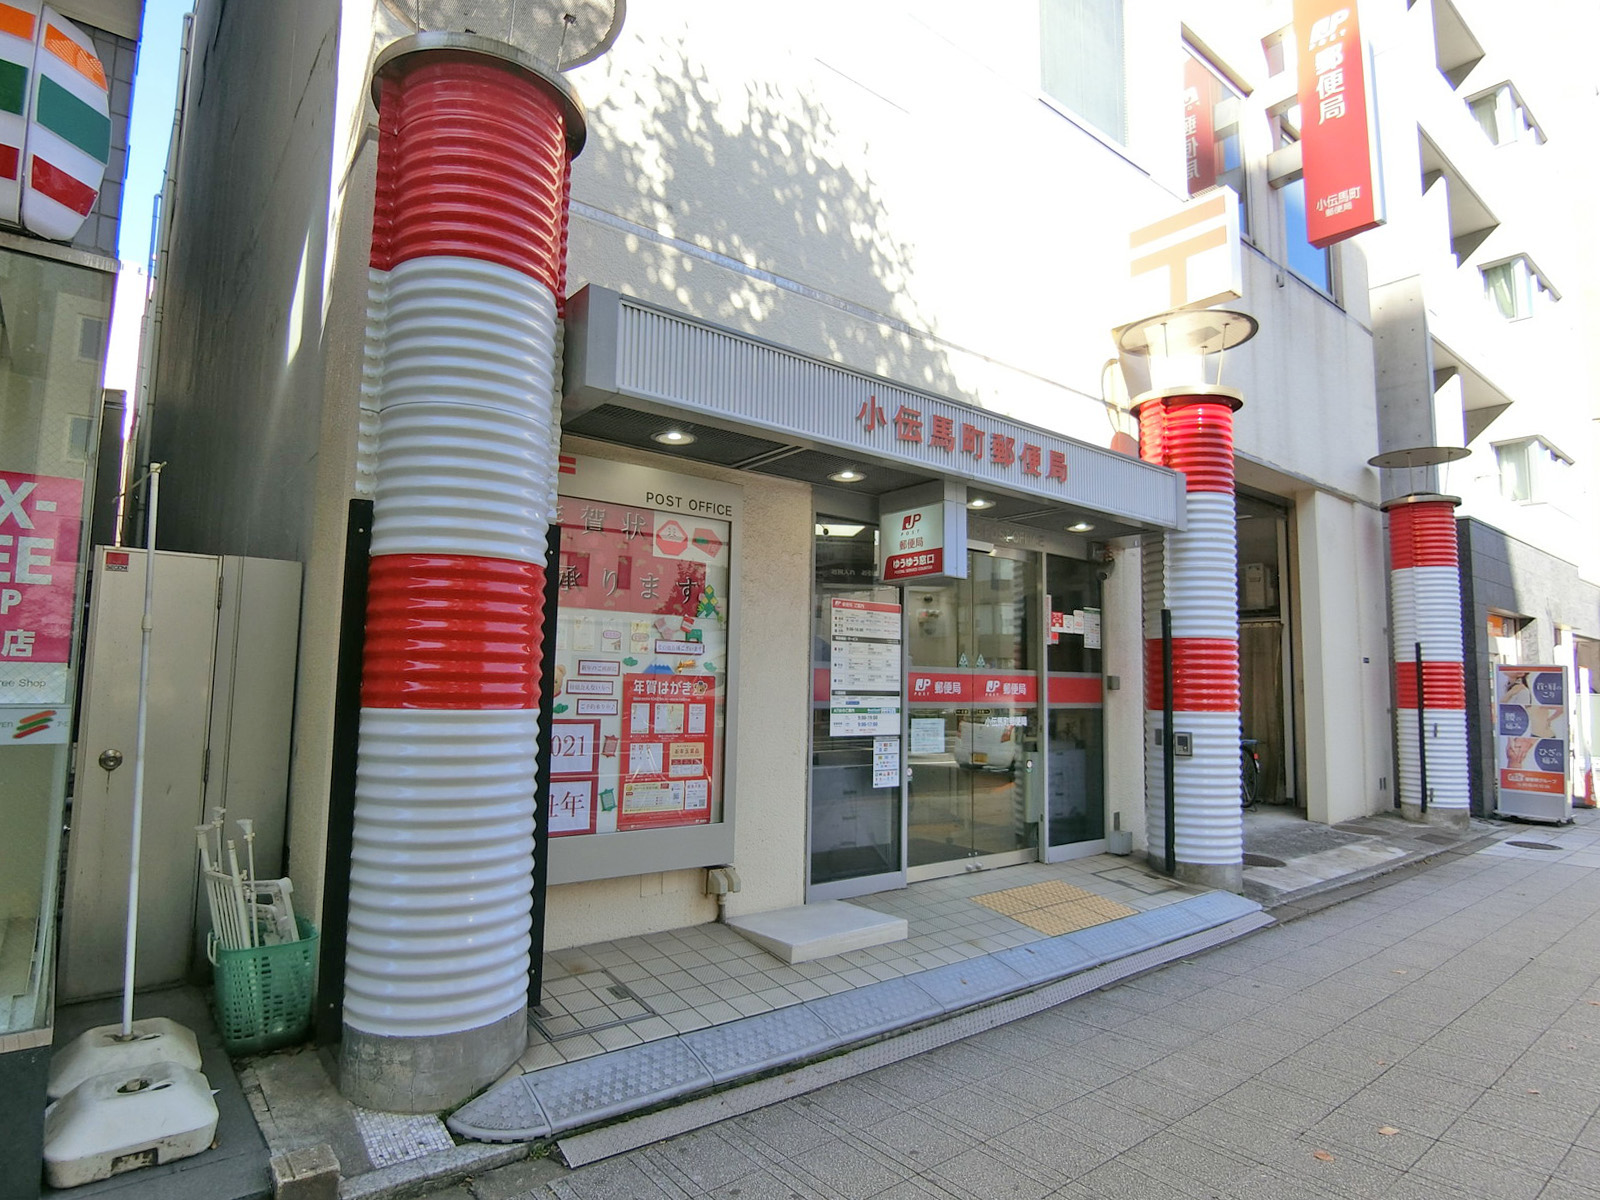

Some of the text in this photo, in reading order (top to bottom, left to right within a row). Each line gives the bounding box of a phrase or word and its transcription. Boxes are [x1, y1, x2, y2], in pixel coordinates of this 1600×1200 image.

[1315, 43, 1346, 125] 郵便局
[1316, 186, 1361, 212] 小伝馬町
[1325, 202, 1353, 217] 郵便局
[856, 395, 1068, 483] 小伝馬町郵便局
[646, 492, 732, 517] POST OFFICE
[900, 529, 920, 537] POST
[899, 537, 924, 551] 郵便局
[893, 554, 935, 570] ゆうゆう窓口
[558, 564, 700, 605] 承ります
[3, 629, 35, 657] 店
[18, 678, 47, 689] Shop
[633, 679, 692, 696] 年賀はがき
[934, 681, 961, 695] 郵便局
[1003, 682, 1027, 695] 郵便局
[1539, 748, 1562, 757] ひざの
